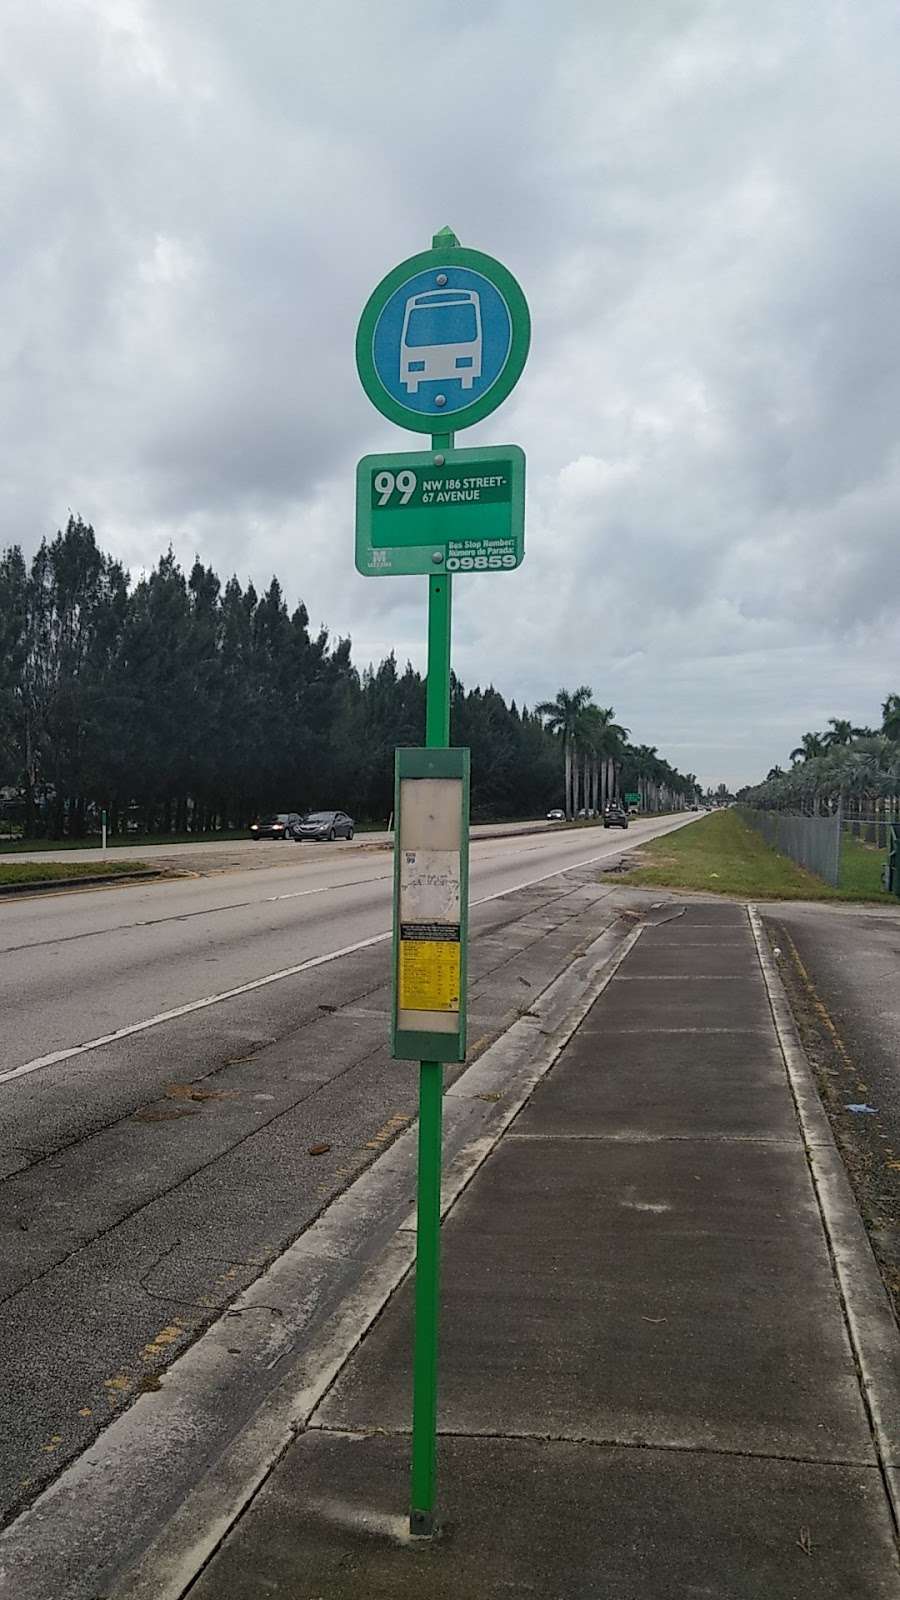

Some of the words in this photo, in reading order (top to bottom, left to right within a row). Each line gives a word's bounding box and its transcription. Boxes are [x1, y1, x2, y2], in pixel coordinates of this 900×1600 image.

[374, 470, 417, 506] 99
[422, 480, 443, 491] NW
[445, 479, 461, 490] 186
[462, 476, 507, 488] STREET-
[422, 492, 435, 503] 67
[436, 489, 480, 502] AVENUE
[448, 541, 463, 549] Bus
[464, 540, 481, 549] Stop
[446, 555, 517, 570] 09859
